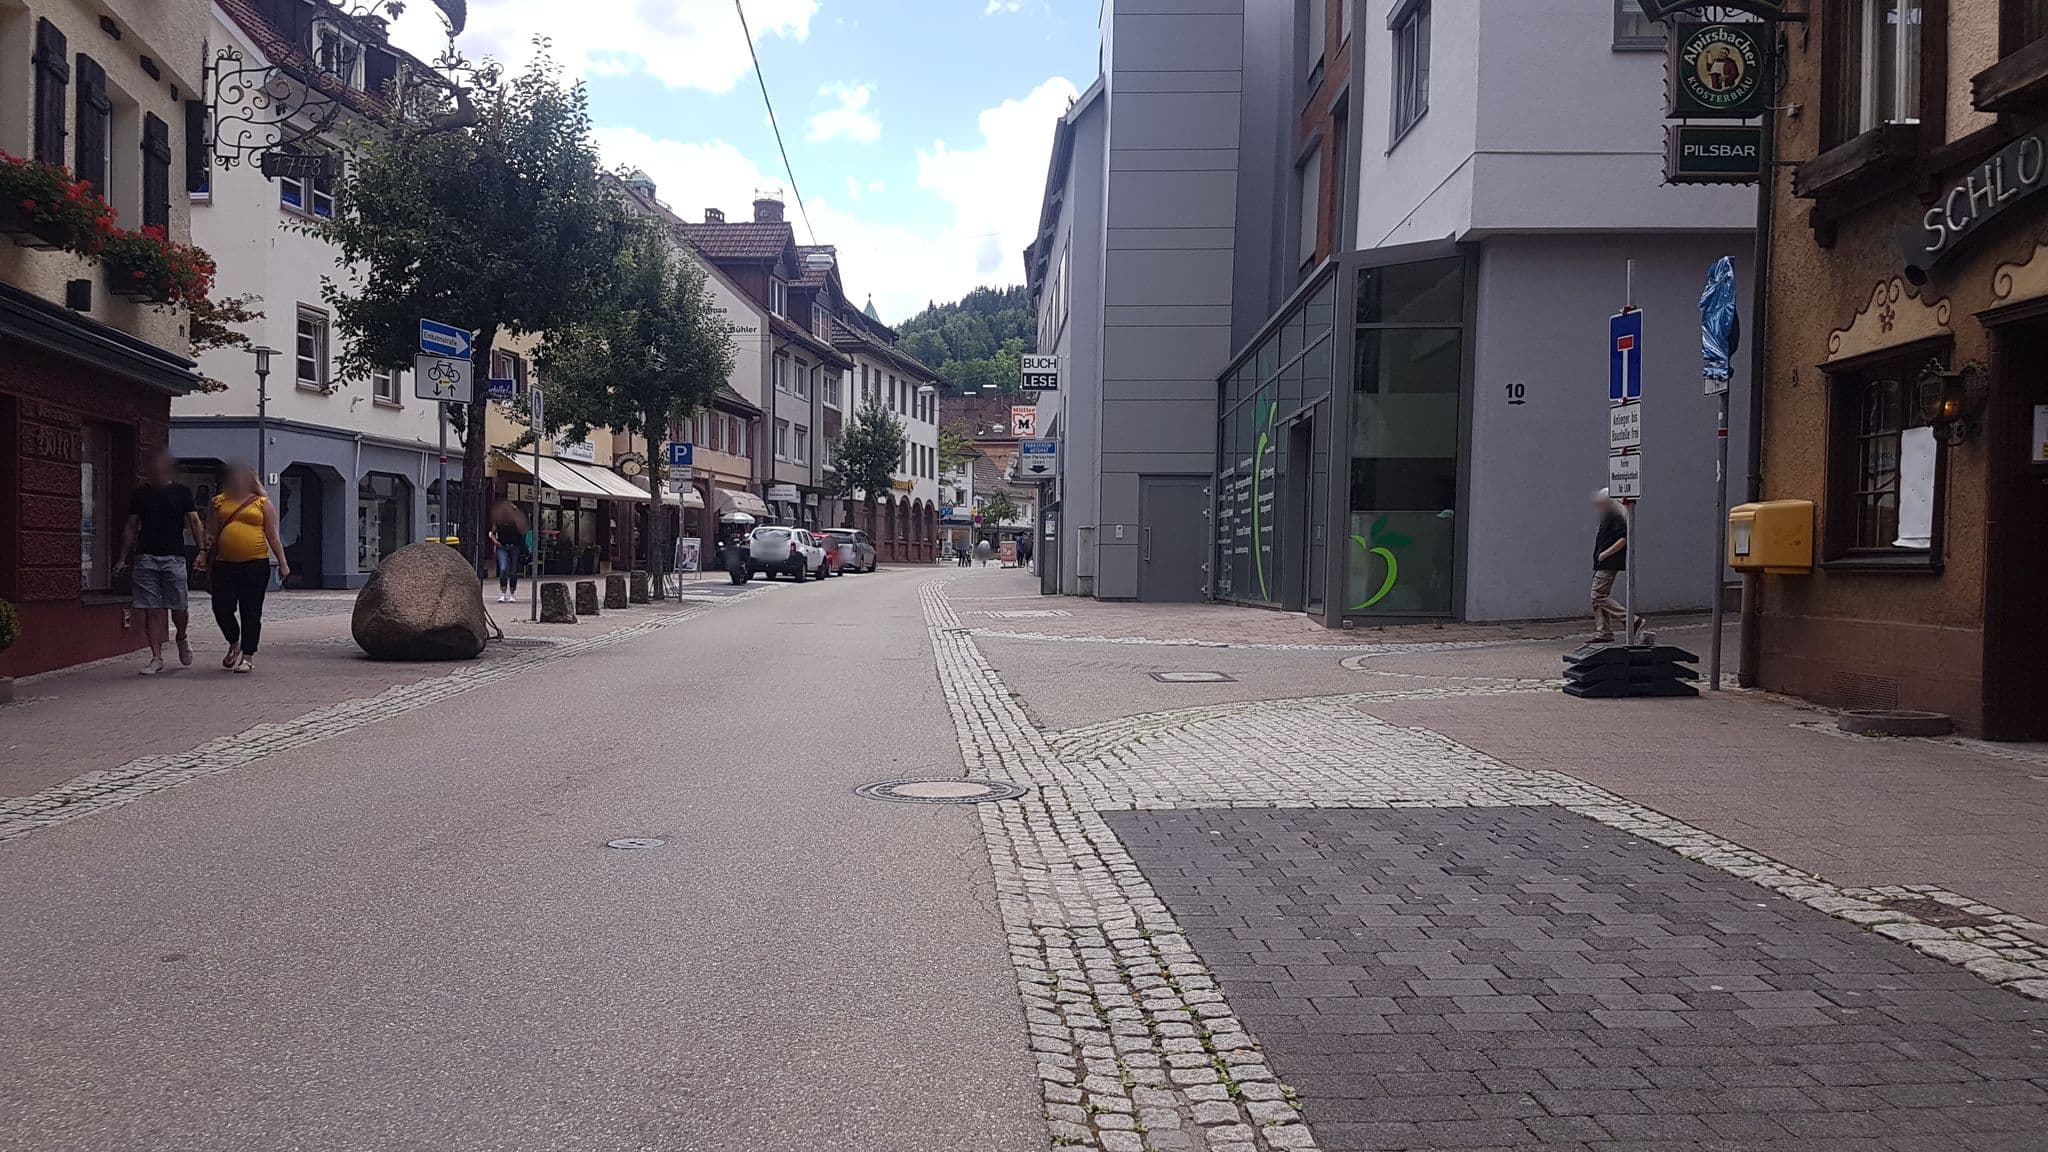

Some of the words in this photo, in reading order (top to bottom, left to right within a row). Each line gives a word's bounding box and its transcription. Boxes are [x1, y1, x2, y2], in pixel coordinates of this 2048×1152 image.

[1684, 28, 1756, 67] Alpirsbacher
[1687, 76, 1753, 103] KLOSTERBRÄU
[1684, 144, 1756, 157] PILSBAR
[1023, 358, 1057, 369] BUCH
[1023, 375, 1057, 387] LESE
[1505, 383, 1525, 398] 10
[1018, 420, 1030, 429] M
[1613, 413, 1630, 427] Anlieger
[675, 445, 687, 462] P
